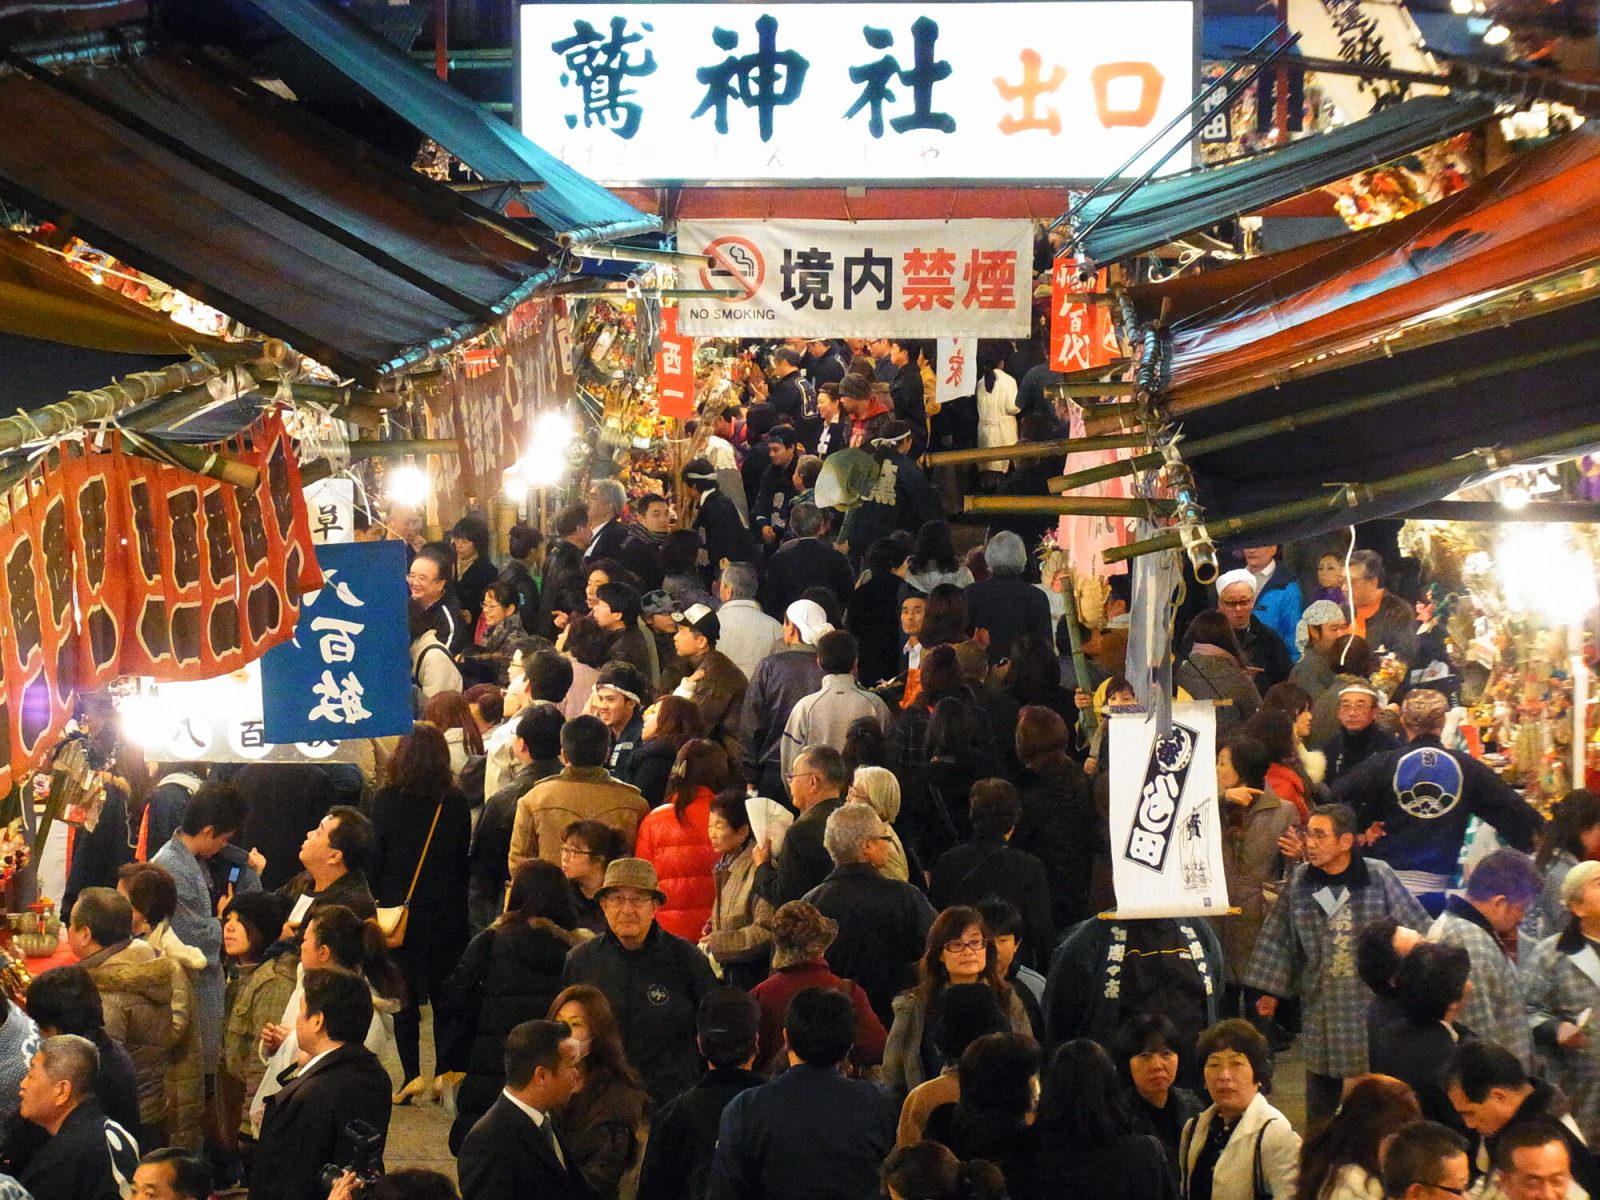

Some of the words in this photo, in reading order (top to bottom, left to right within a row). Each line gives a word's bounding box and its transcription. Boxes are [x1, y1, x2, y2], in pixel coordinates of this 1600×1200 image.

[552, 14, 956, 141] 鷲神社
[993, 48, 1165, 136] 出口
[780, 248, 1016, 311] 境内禁煙
[690, 309, 709, 320] NO
[713, 308, 775, 321] SMOKING
